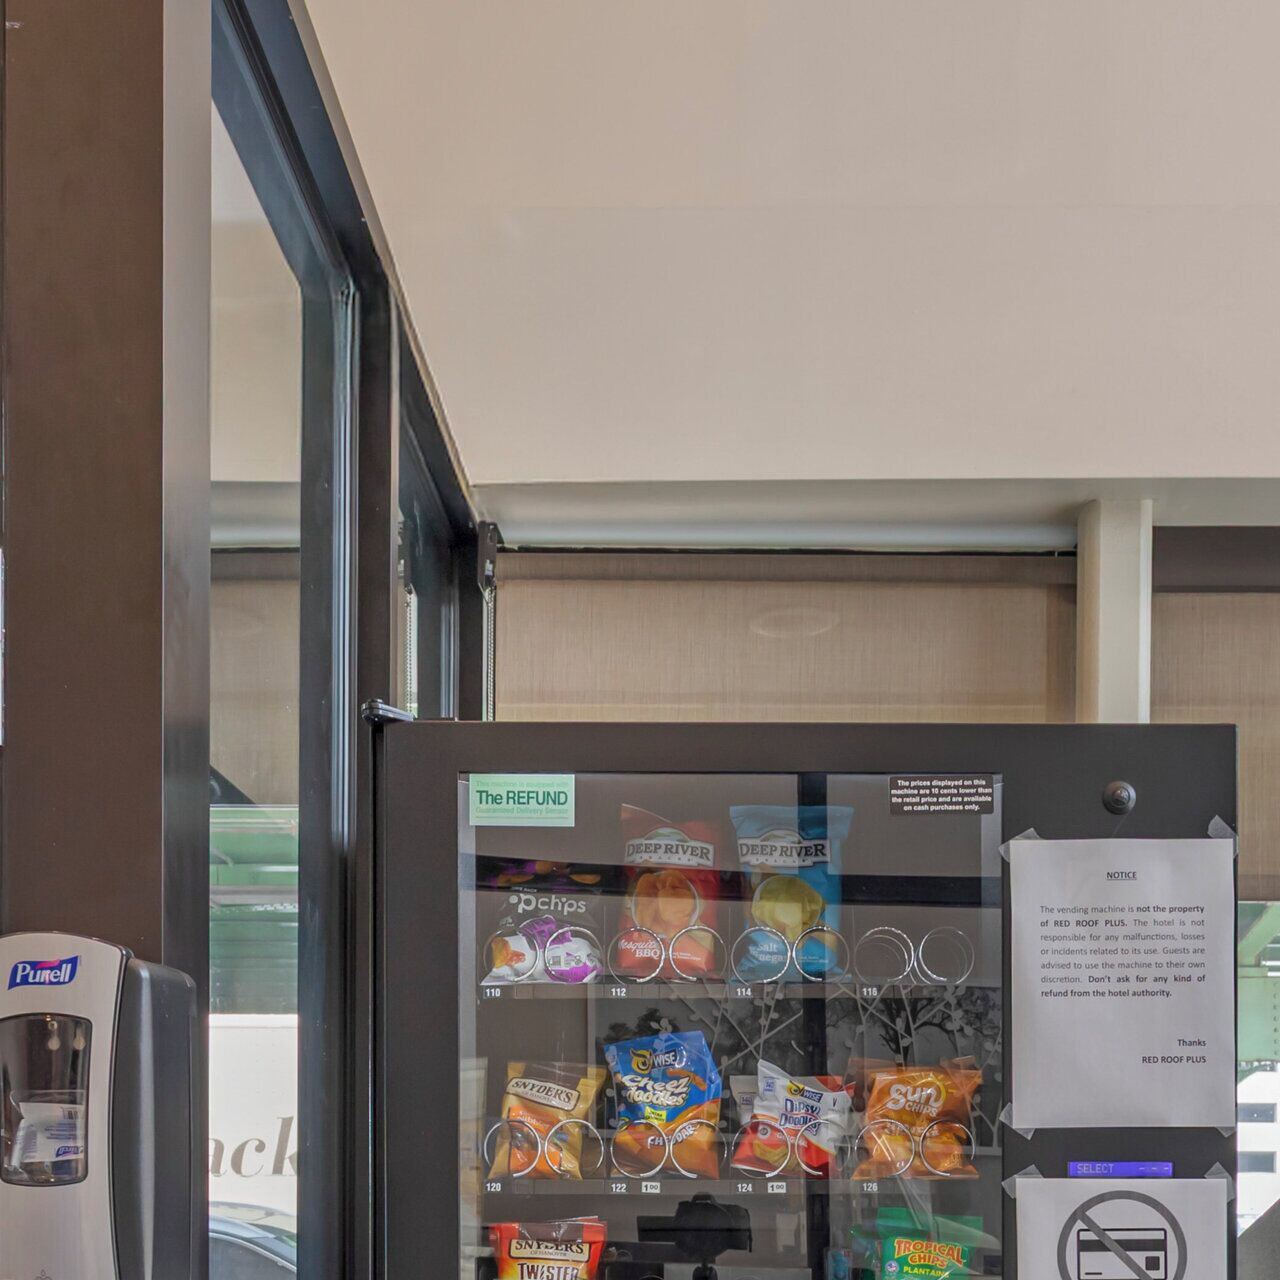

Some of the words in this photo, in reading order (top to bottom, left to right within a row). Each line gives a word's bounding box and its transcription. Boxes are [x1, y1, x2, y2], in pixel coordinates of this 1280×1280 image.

[476, 790, 503, 805] The
[506, 791, 568, 806] REFUND
[921, 796, 938, 804] price
[930, 804, 963, 812] purchases
[964, 804, 981, 812] only.
[626, 843, 663, 858] DEEP
[663, 843, 712, 861] RIVER
[739, 844, 777, 858] DEEP
[779, 843, 827, 858] RIVER
[1106, 871, 1137, 880] NOTICE
[1040, 905, 1055, 914] The
[1057, 905, 1089, 915] vending
[1091, 904, 1126, 914] machine
[1136, 905, 1151, 913] not
[1152, 904, 1167, 913] the
[1168, 905, 1205, 915] property
[1053, 919, 1071, 928] RED
[1075, 919, 1099, 928] ROOF
[1104, 918, 1128, 928] PLUS.
[1133, 918, 1148, 927] The
[1153, 918, 1175, 927] hotel
[1190, 919, 1205, 927] not
[1040, 933, 1086, 943] responsible
[1089, 932, 1101, 942] for
[1104, 934, 1120, 943] any
[1122, 932, 1178, 942] malfunctions,
[1180, 932, 1205, 941] losses
[635, 949, 660, 959] BBQ
[1051, 947, 1088, 956] incidents
[1089, 947, 1119, 956] related
[1162, 946, 1190, 955] Guests
[1191, 947, 1206, 955] are
[1040, 961, 1071, 970] advised
[1101, 961, 1115, 970] the
[1117, 960, 1153, 970] machine
[1166, 959, 1186, 969] their
[1187, 961, 1206, 969] own
[16, 962, 72, 984] Purell
[1040, 974, 1081, 984] discretion.
[1087, 974, 1111, 984] Don't
[1116, 974, 1131, 984] ask
[1135, 974, 1148, 983] for
[1152, 976, 1168, 985] any
[1173, 973, 1192, 983] kind
[485, 988, 501, 997] 110
[610, 987, 627, 997] 112
[736, 987, 752, 997] 114
[862, 987, 878, 997] 116
[1040, 988, 1068, 998] refund
[1069, 988, 1091, 998] from
[1092, 988, 1107, 998] the
[1107, 988, 1130, 998] hotel
[1131, 988, 1173, 999] authority.
[1177, 1037, 1207, 1047] Thanks
[653, 1051, 677, 1067] WISE
[1141, 1055, 1159, 1064] RED
[1160, 1055, 1183, 1064] ROOF
[1185, 1055, 1207, 1064] PLUS
[511, 1080, 574, 1104] SNYDER'S
[802, 1090, 822, 1101] WISE
[904, 1101, 939, 1118] CHIPS
[1076, 1163, 1115, 1174] SELECT
[486, 1182, 501, 1192] 120
[611, 1183, 627, 1192] 122
[737, 1183, 752, 1192] 124
[862, 1182, 878, 1192] 126
[894, 1238, 964, 1267] TROPICAL
[908, 1253, 948, 1269] CHIPS
